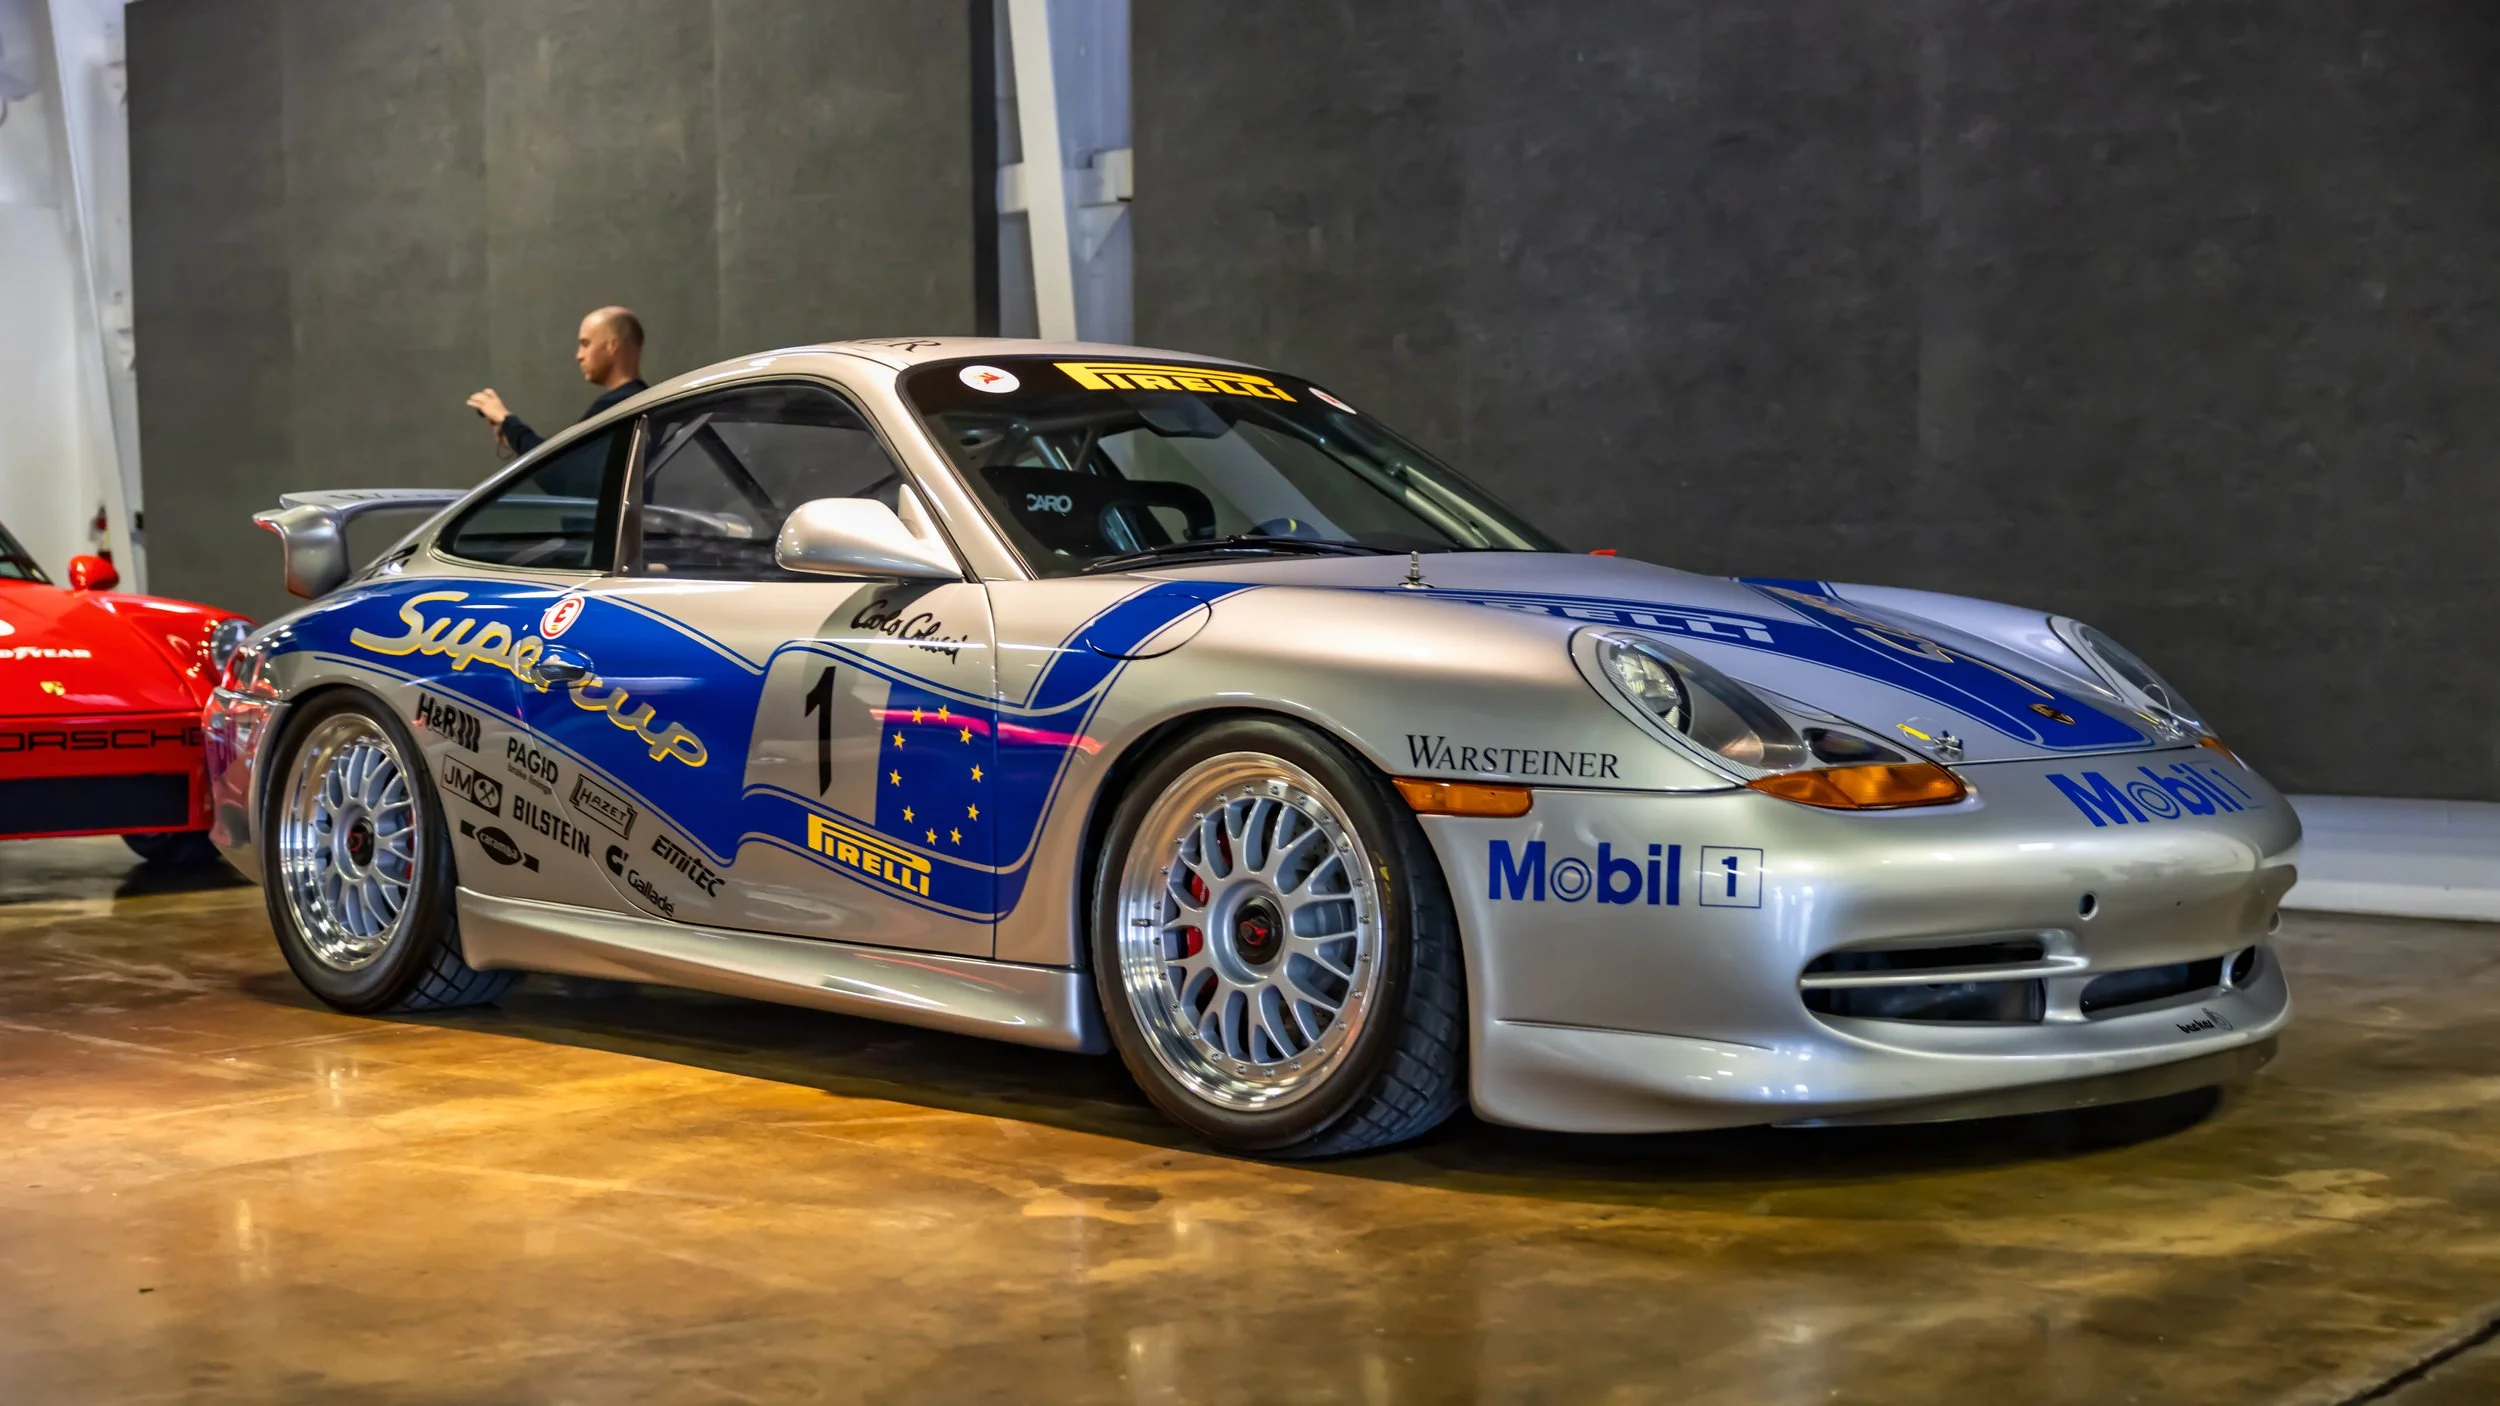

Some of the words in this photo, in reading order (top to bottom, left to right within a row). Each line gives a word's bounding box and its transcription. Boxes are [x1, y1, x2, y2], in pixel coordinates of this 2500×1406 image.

[1053, 362, 1299, 403] PIRELLI
[349, 591, 709, 768] Supecup
[415, 692, 457, 737] H&R
[804, 665, 837, 798] 1
[444, 765, 472, 795] JM
[506, 736, 559, 786] PAGID
[1405, 734, 1621, 779] WARSTEINER
[580, 787, 628, 821] HAZET
[2045, 762, 2245, 828] Mobil
[512, 794, 591, 858] BILSTEIN
[807, 812, 933, 898] PIRELLI
[1488, 838, 1683, 906] Mobil
[1721, 855, 1739, 898] 1
